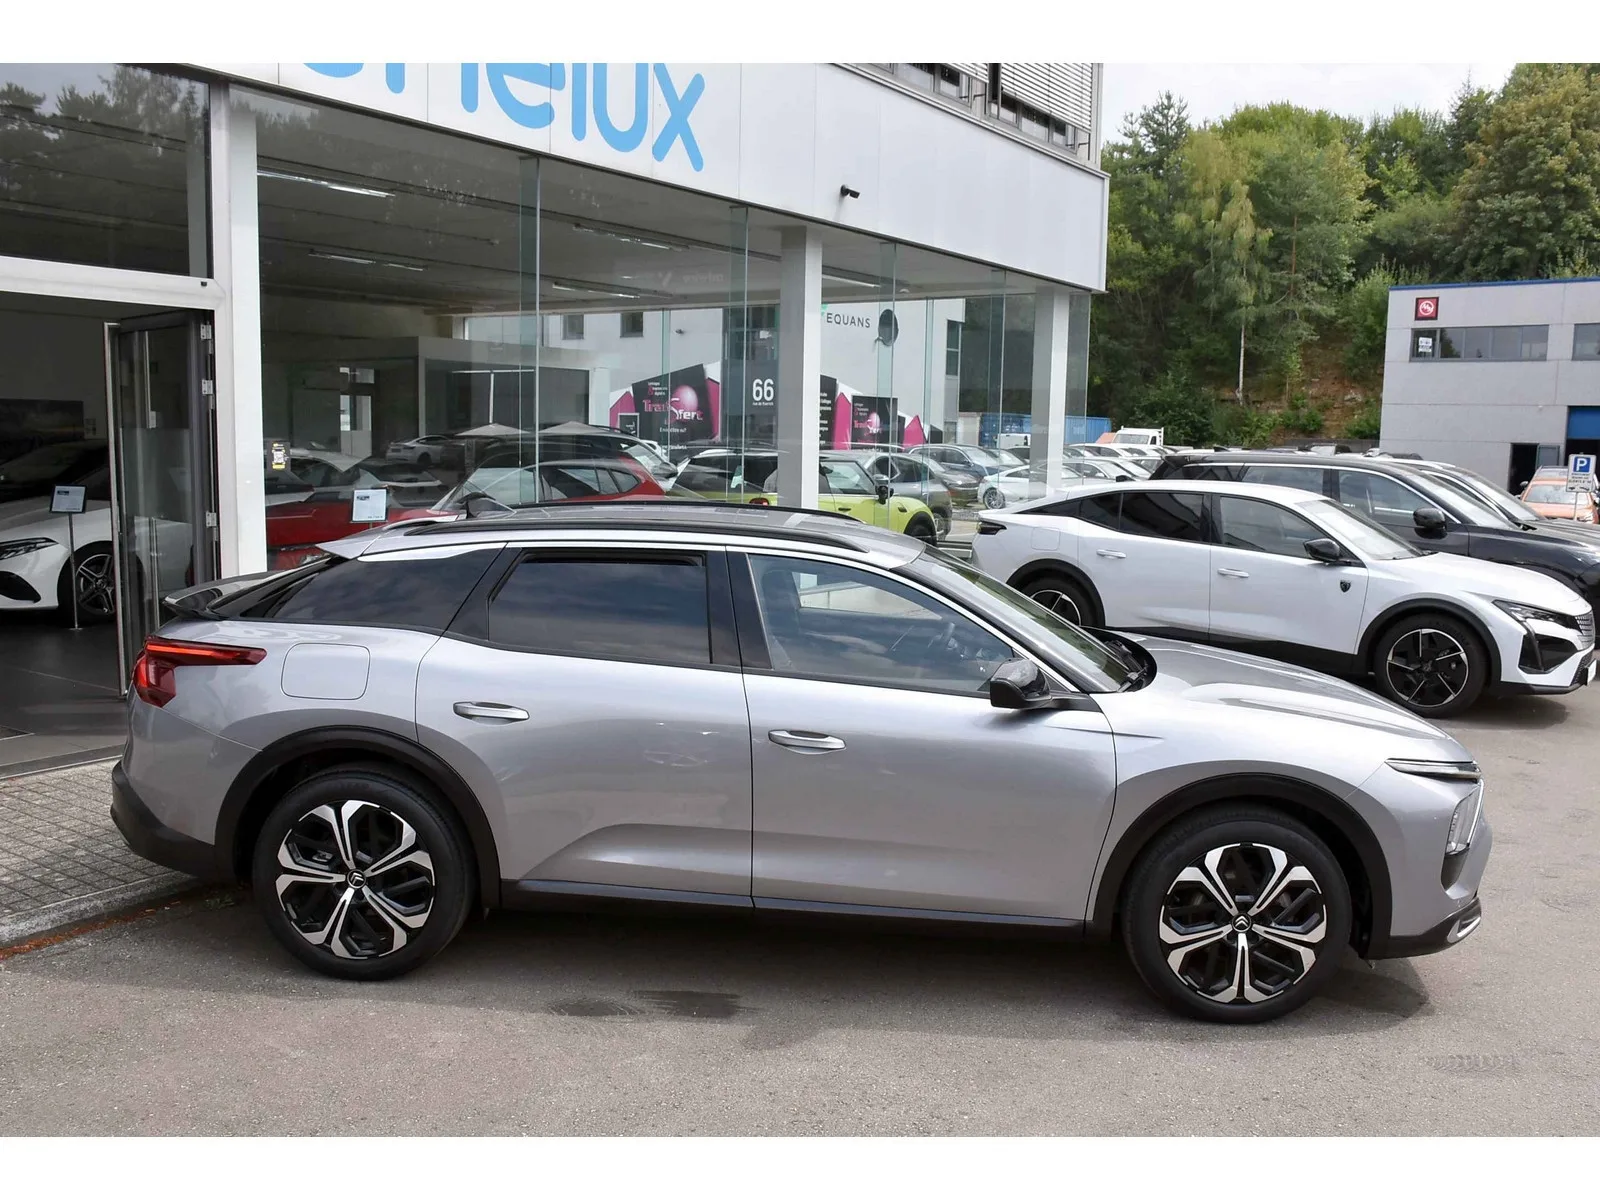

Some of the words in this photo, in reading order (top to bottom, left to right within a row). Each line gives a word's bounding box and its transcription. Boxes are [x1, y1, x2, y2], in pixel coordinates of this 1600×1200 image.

[303, 63, 705, 172] elux
[826, 312, 871, 329] EQUANS
[752, 378, 774, 401] 66
[1575, 457, 1588, 472] P
